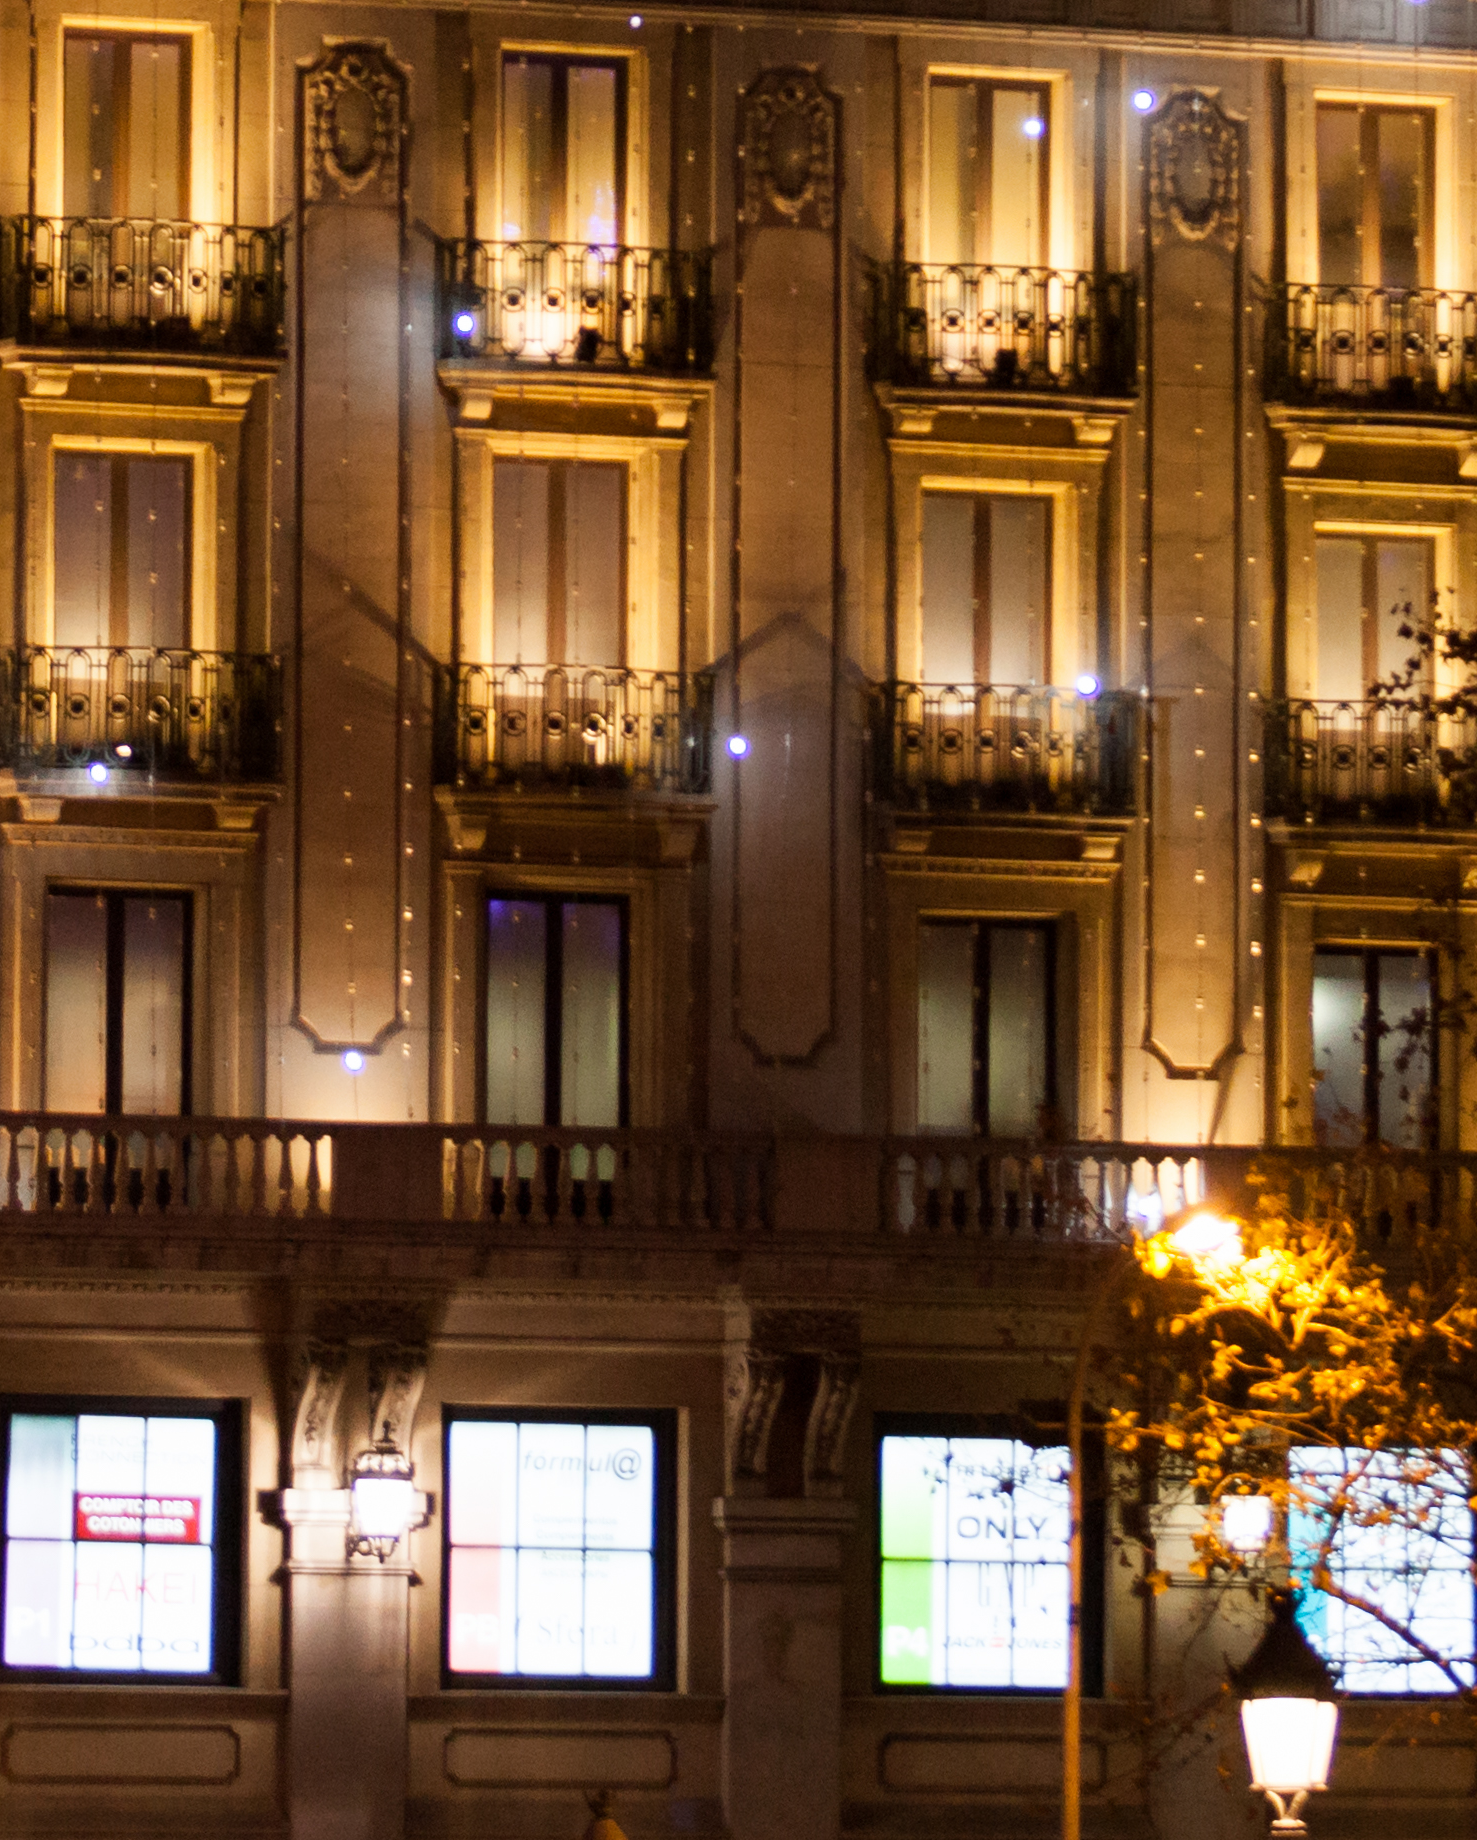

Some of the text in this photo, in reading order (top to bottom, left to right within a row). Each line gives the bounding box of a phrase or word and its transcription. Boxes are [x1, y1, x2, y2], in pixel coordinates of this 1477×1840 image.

[161, 1500, 194, 1518] DES
[955, 1514, 1050, 1541] ONLY
[75, 1569, 197, 1605] HAKEI
